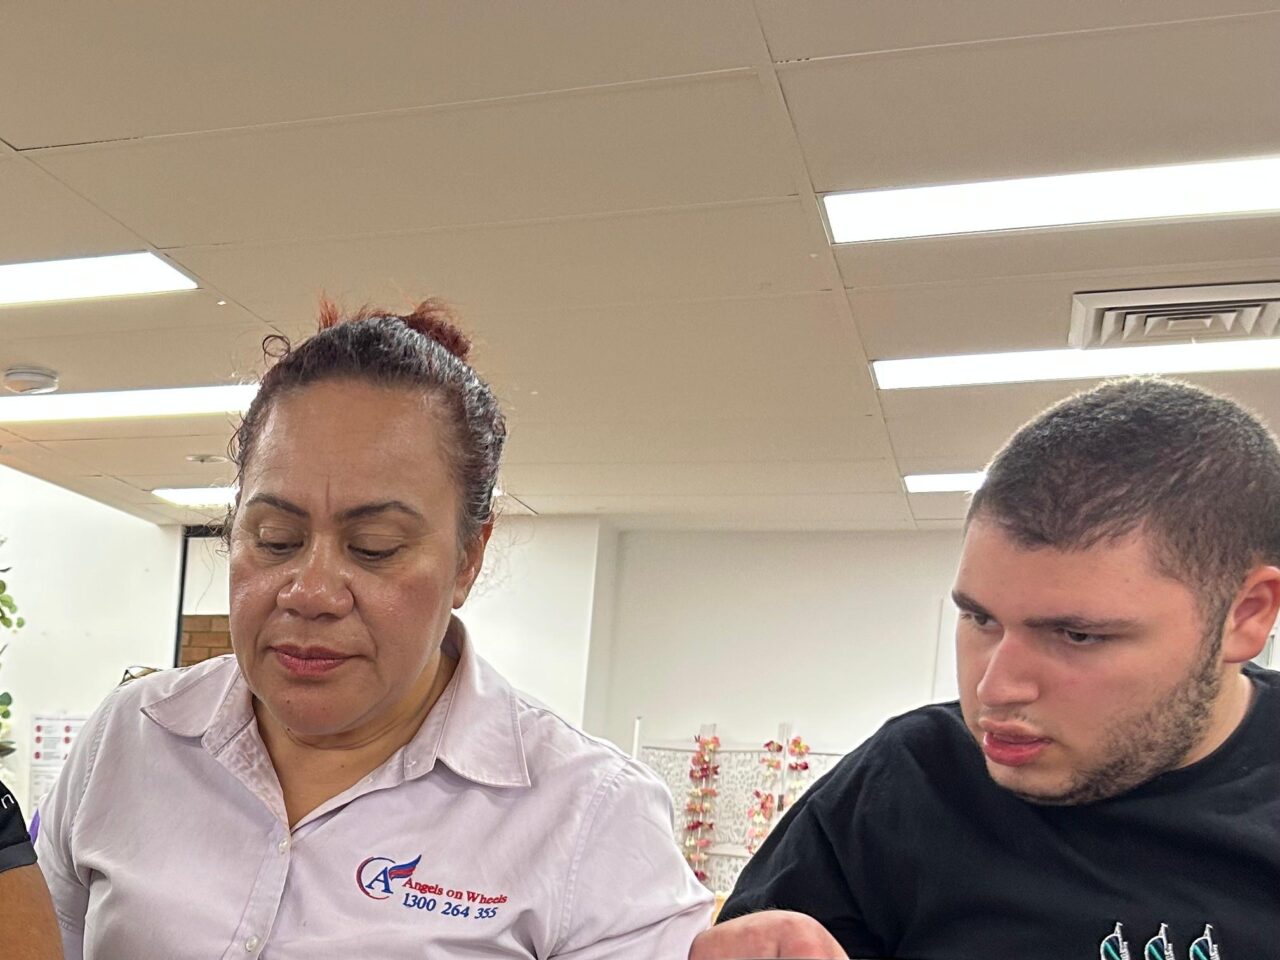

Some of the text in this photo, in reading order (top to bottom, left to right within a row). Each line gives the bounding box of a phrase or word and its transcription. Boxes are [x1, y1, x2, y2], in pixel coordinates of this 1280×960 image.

[402, 877, 508, 905] Angels on Wheels
[403, 892, 499, 920] 1300 264 355
